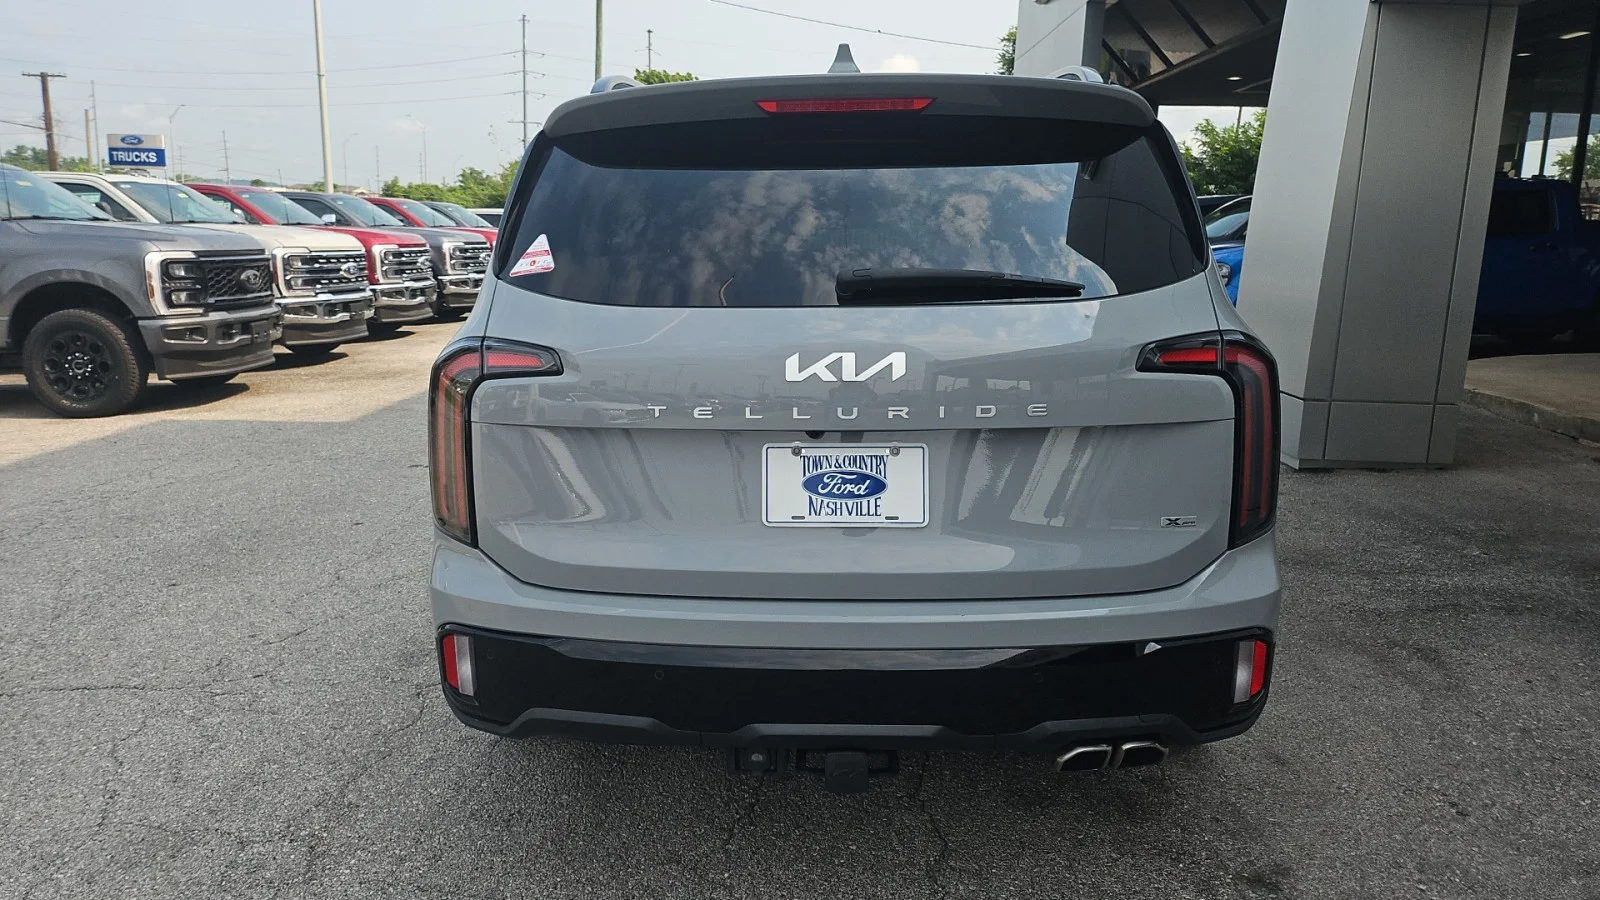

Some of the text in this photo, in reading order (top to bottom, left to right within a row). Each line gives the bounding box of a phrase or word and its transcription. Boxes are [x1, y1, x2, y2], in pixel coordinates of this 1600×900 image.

[111, 151, 157, 163] TRUCKS
[785, 351, 906, 382] KIA
[648, 403, 1048, 419] TELLURIDE
[800, 454, 890, 480] TOWN & COUNTRY
[818, 472, 871, 495] Ford
[808, 496, 882, 517] NASHVILLE
